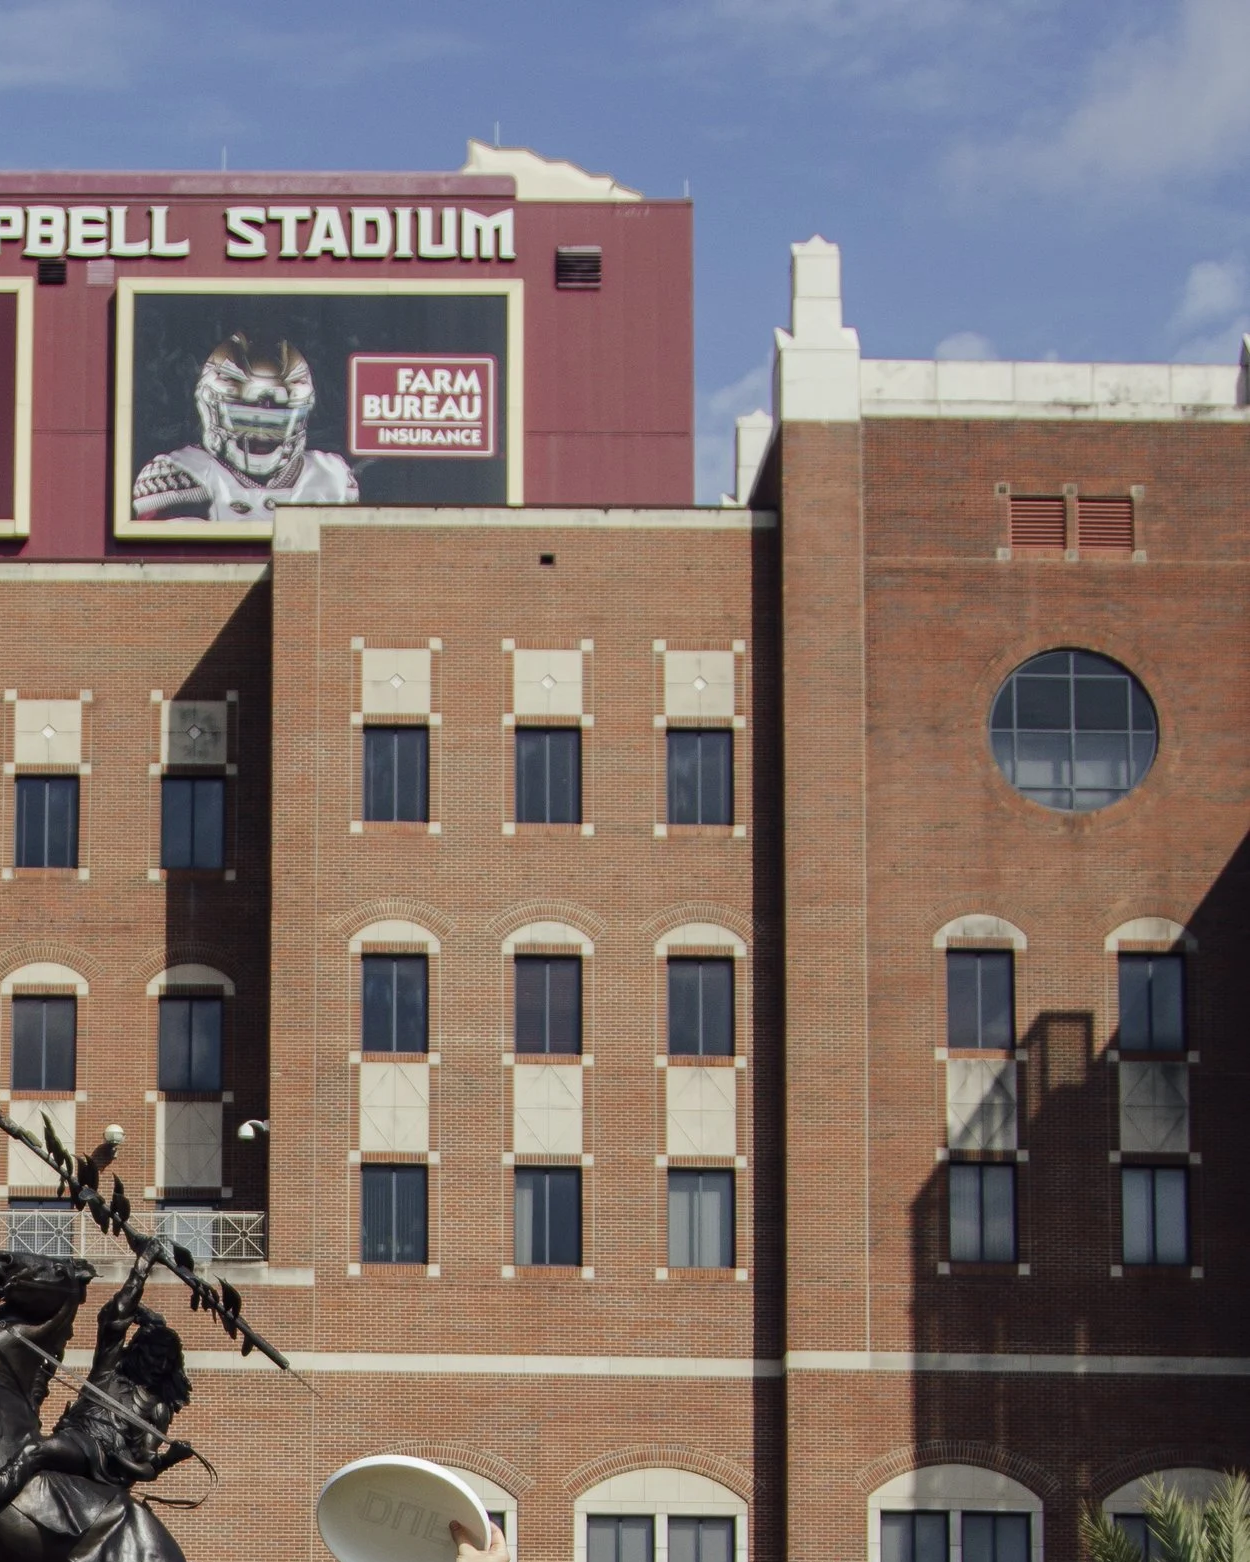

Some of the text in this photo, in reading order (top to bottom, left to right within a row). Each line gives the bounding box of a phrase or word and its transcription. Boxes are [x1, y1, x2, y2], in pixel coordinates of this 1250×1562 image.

[225, 206, 517, 258] STADIUM
[398, 368, 482, 395] FARM
[362, 394, 482, 421] BUREAU
[378, 428, 482, 446] INSURANCE
